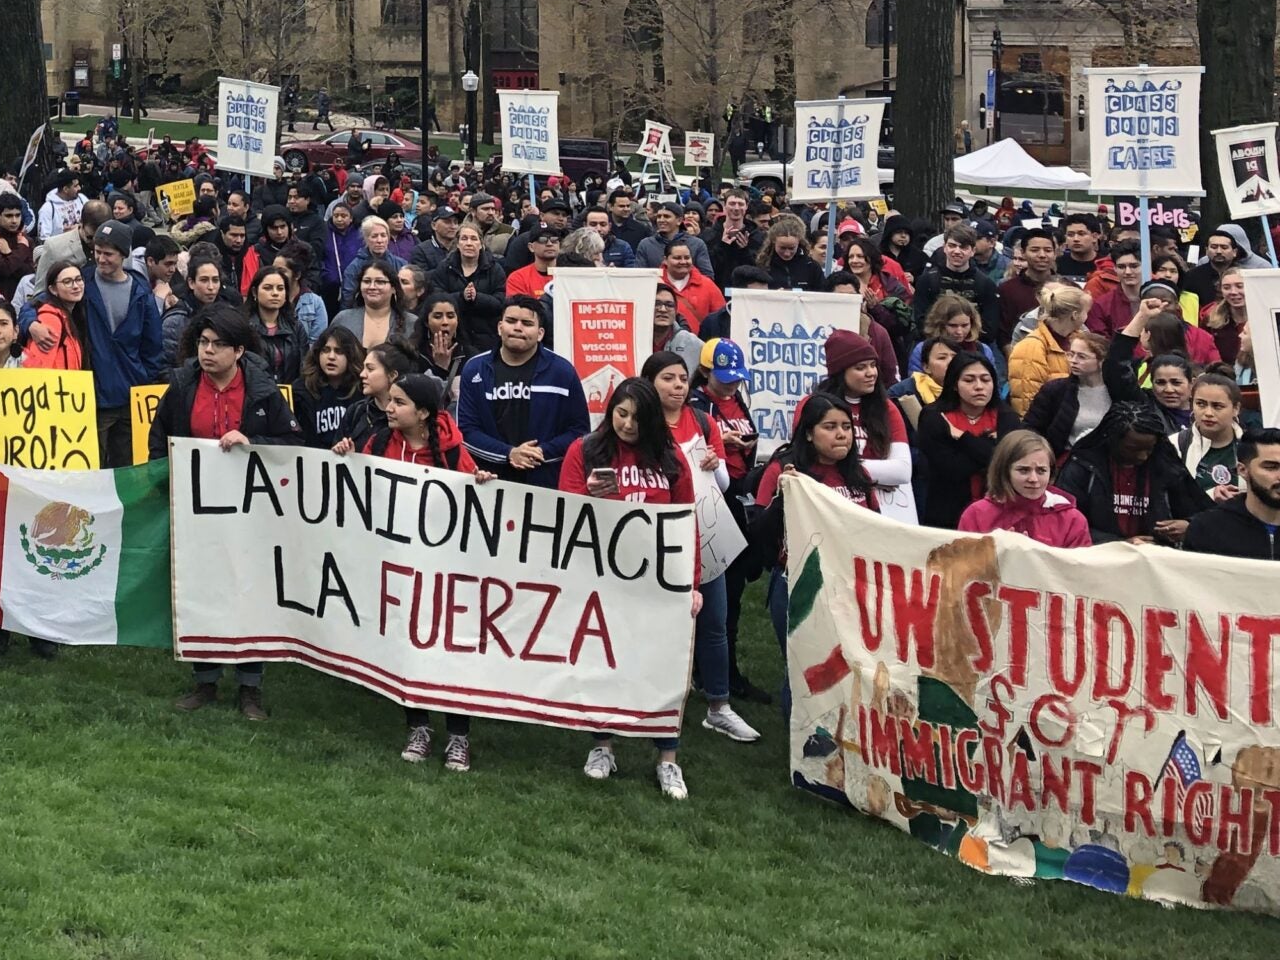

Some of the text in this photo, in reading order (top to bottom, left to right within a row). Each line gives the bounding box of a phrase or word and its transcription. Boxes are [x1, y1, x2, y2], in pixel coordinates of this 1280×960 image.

[1107, 94, 1177, 113] CLASS
[808, 126, 864, 143] CLASS
[1107, 116, 1178, 136] ROOMS
[807, 144, 863, 161] ROOMS
[1108, 145, 1176, 170] CAGES
[578, 304, 627, 314] IN-STATE
[581, 320, 626, 330] TUITION
[55, 376, 86, 413] tu
[750, 369, 828, 396] ROOM
[192, 448, 284, 516] LA
[519, 492, 693, 592] HACE
[274, 545, 616, 669] LA FUERZA
[853, 555, 942, 670] UW
[979, 673, 1158, 765] for
[858, 703, 1104, 826] IMMIGRANT
